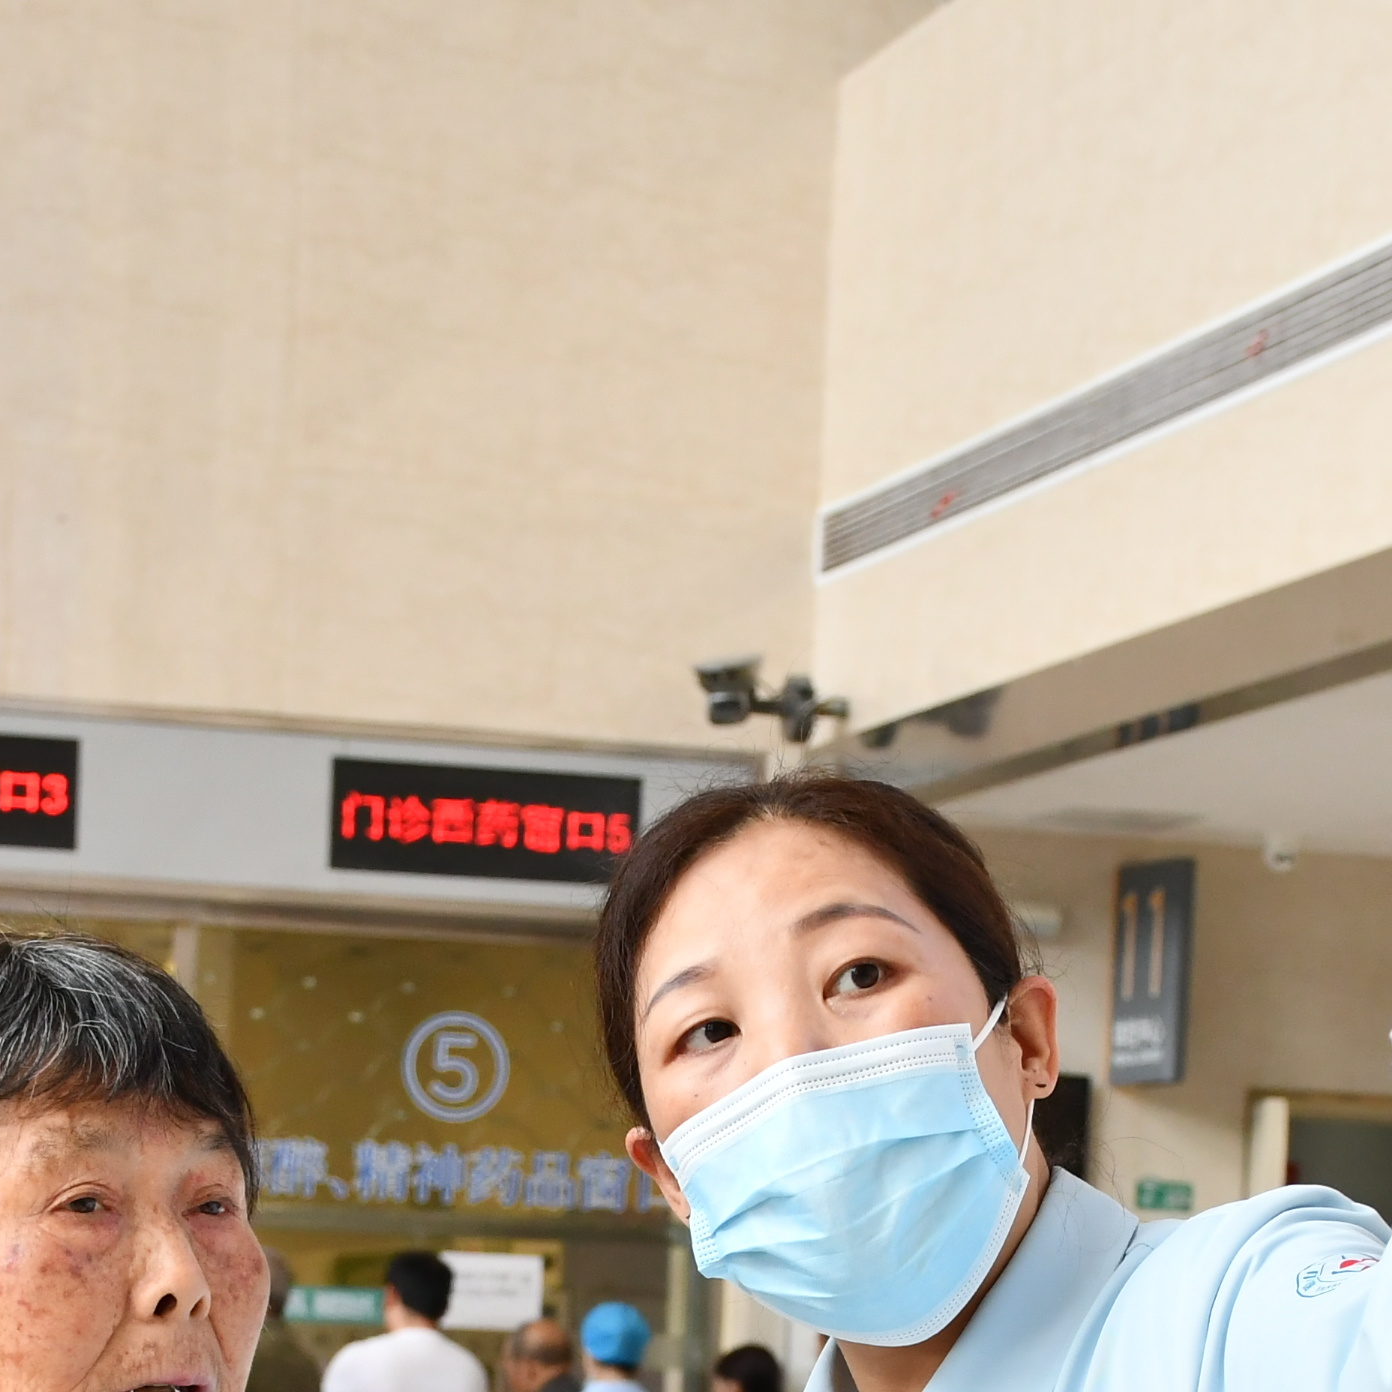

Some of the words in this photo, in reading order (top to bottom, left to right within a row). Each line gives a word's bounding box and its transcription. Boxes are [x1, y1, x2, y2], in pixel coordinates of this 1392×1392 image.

[339, 790, 632, 855] 门诊西药窗口5
